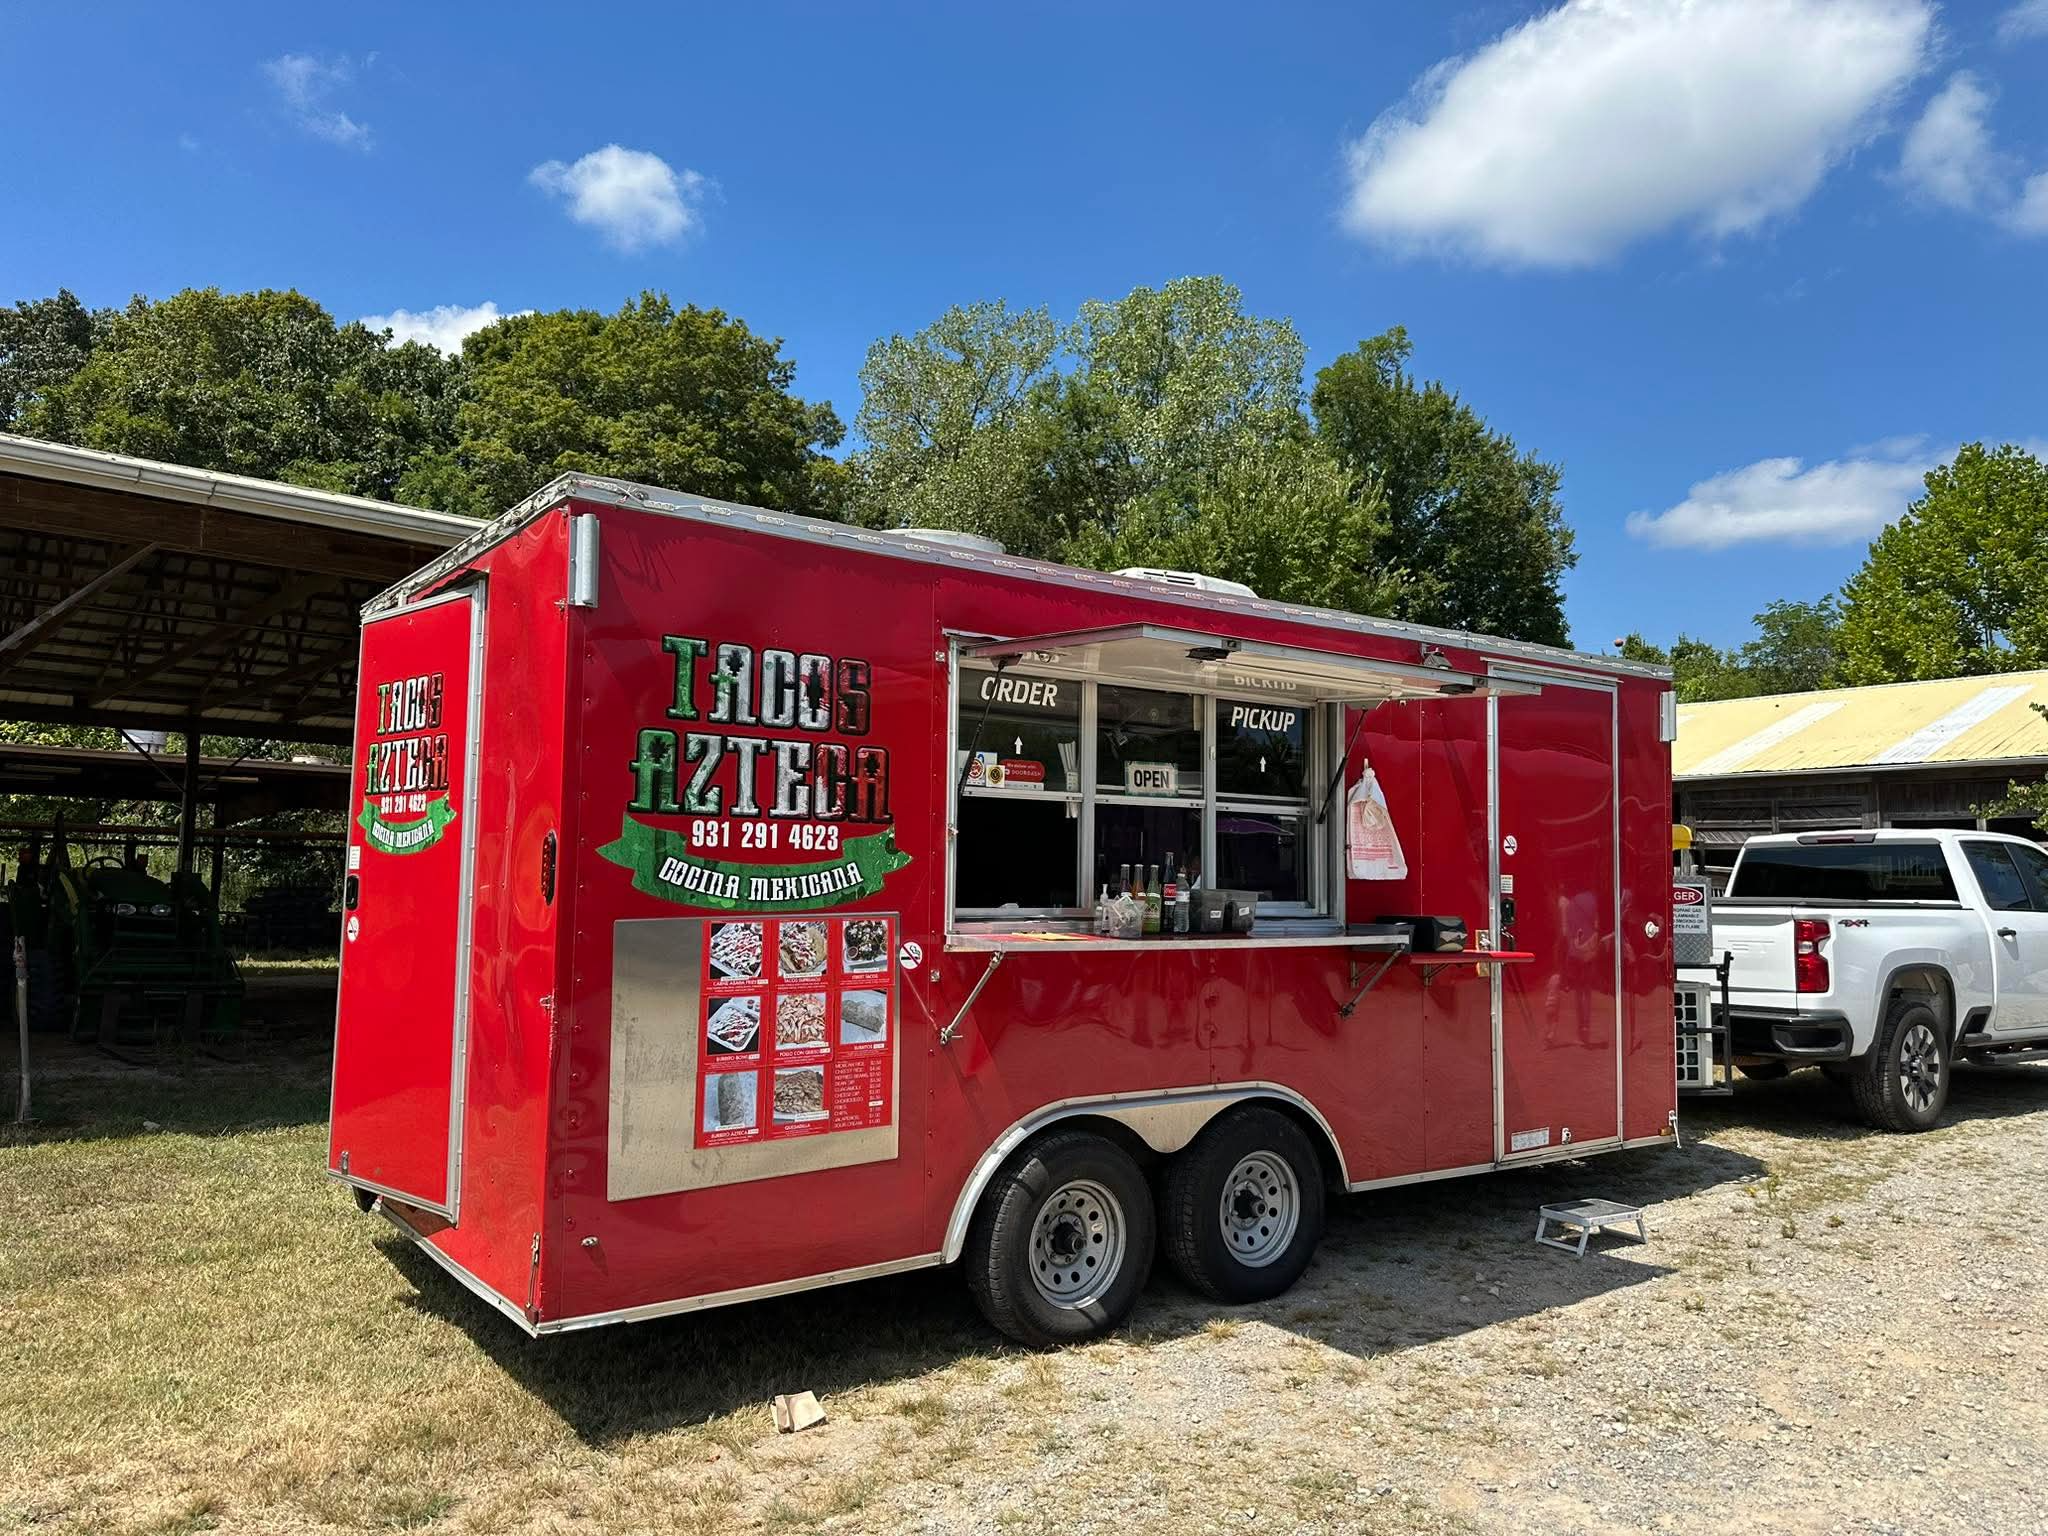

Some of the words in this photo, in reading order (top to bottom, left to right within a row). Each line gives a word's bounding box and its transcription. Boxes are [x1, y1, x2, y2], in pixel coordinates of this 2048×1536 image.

[376, 672, 444, 735] TACOS
[661, 635, 871, 736] TACOS
[981, 676, 1058, 707] ORDER
[1231, 706, 1296, 732] PICKUP
[365, 735, 449, 796] AZTECA
[627, 728, 893, 824] AZTECA
[1134, 769, 1170, 788] OPEN
[691, 819, 730, 847] 931
[741, 822, 778, 849] 291
[788, 824, 839, 851] 4623
[658, 855, 740, 899] COCINA
[748, 861, 864, 901] MEXICANA
[1673, 891, 1696, 901] GER
